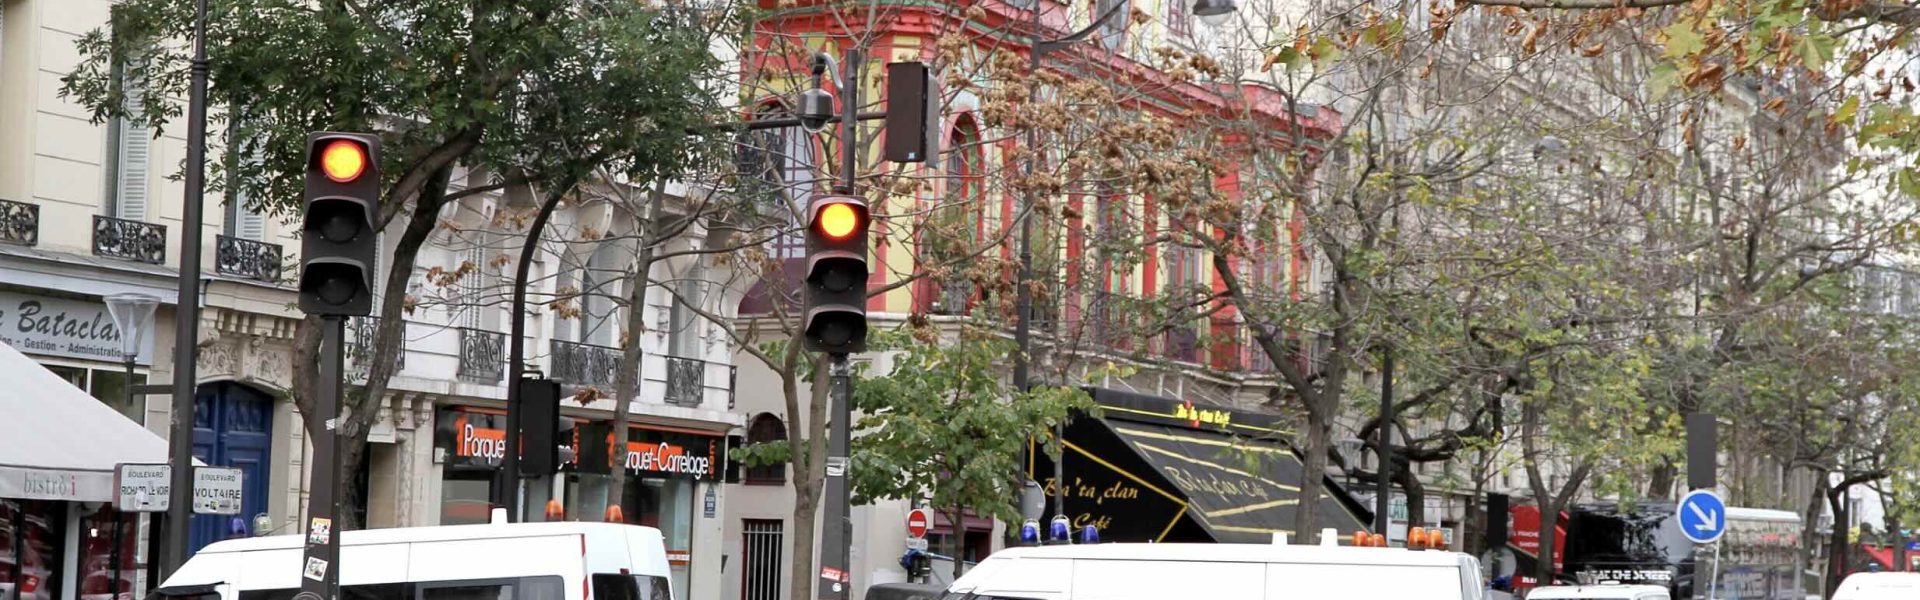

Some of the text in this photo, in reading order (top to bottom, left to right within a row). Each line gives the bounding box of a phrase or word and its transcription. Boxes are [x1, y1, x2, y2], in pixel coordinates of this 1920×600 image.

[24, 338, 56, 351] Gestion
[68, 343, 123, 358] Administratio
[201, 473, 236, 482] BOULEVARD
[194, 488, 241, 499] VOLTAIRE
[1612, 569, 1632, 580] THE
[1632, 569, 1672, 581] STREET
